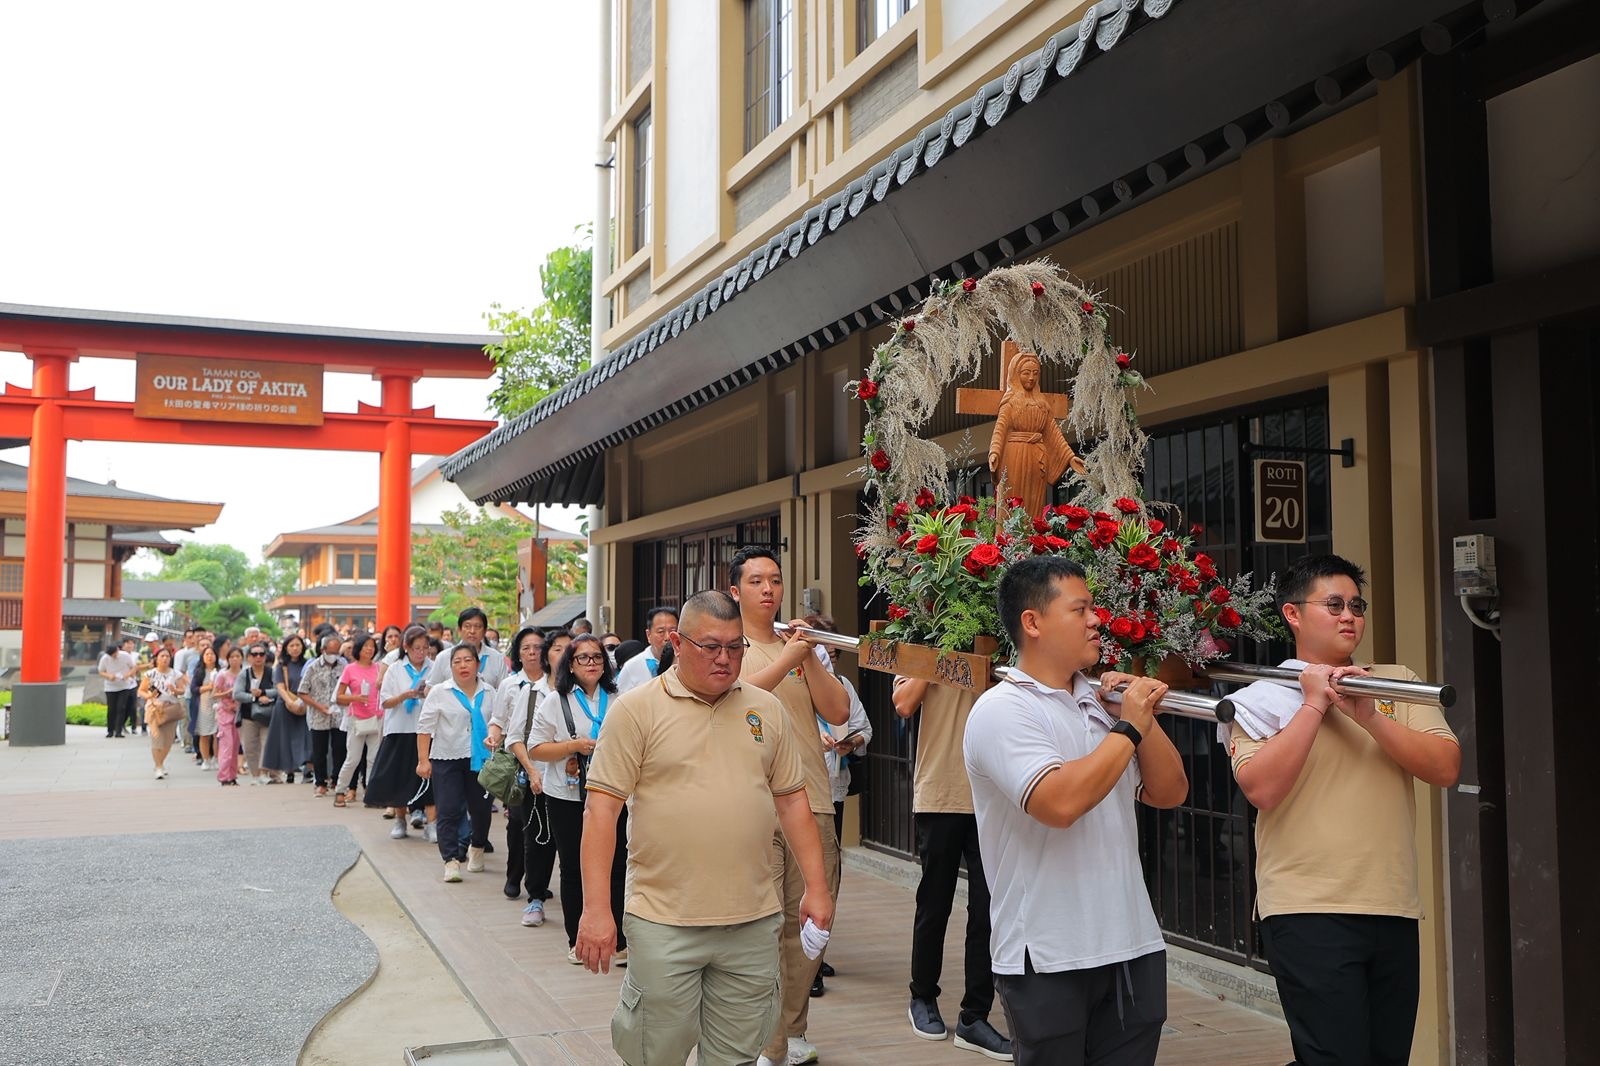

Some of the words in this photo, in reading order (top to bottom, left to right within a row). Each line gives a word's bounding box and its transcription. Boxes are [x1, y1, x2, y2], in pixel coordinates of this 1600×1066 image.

[203, 368, 238, 378] TAMAN
[239, 370, 262, 379] DOA
[153, 375, 188, 391] OUR
[192, 377, 233, 393] LADY
[237, 379, 258, 394] OF
[261, 382, 307, 397] AKITA
[1267, 467, 1296, 480] ROTI
[1265, 497, 1300, 528] 20
